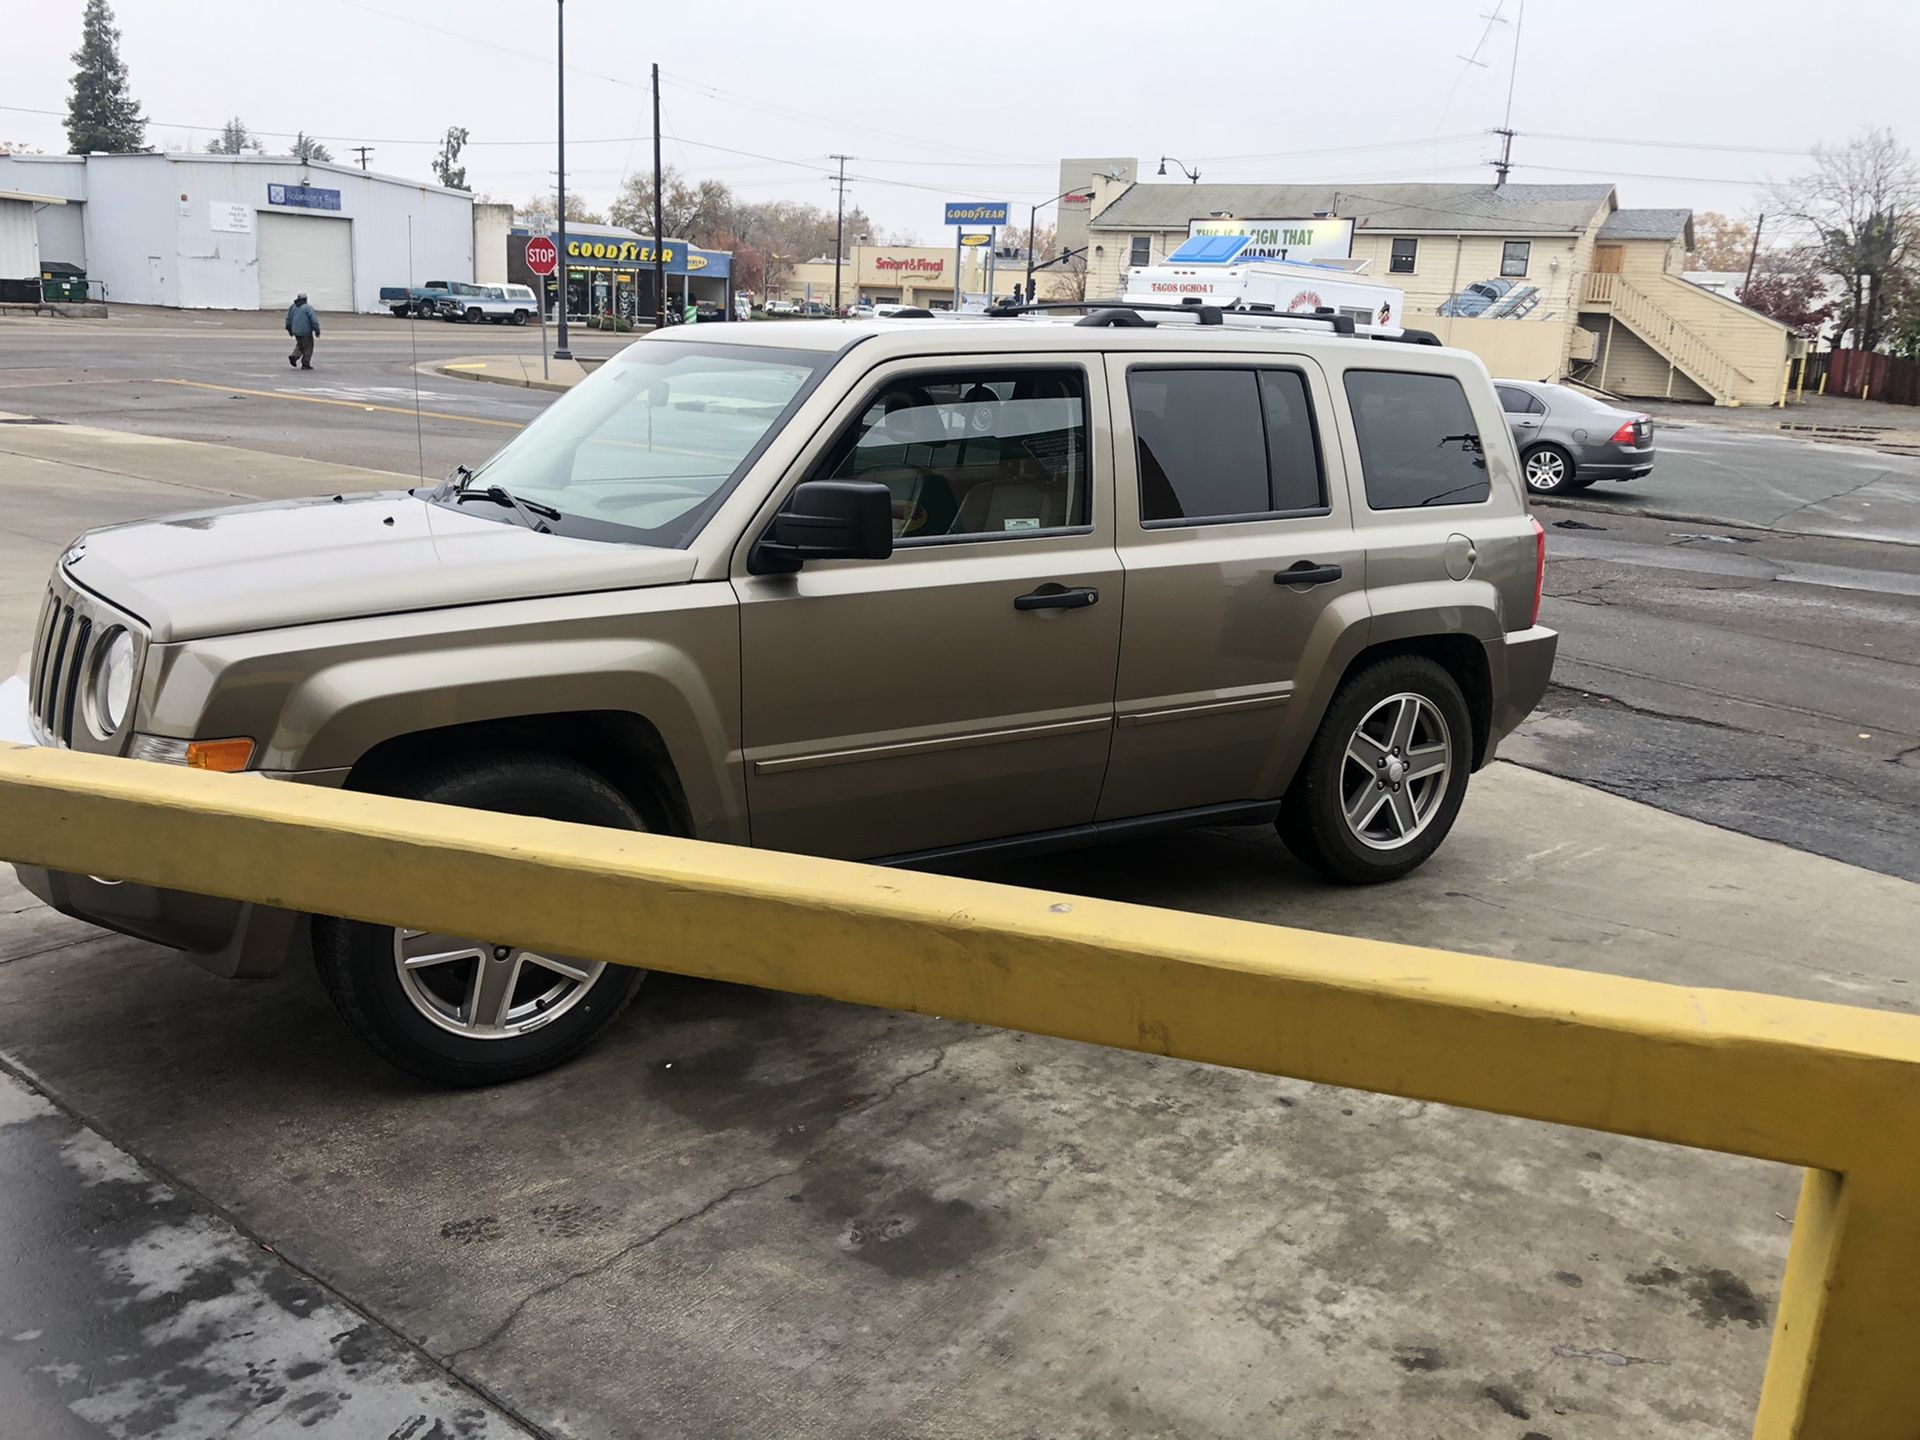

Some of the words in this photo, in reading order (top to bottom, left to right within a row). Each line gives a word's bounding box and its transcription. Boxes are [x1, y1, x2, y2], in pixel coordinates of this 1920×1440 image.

[947, 206, 1005, 221] GOODYEAR
[1250, 229, 1278, 245] SIGN
[1283, 229, 1314, 245] THAT
[528, 248, 555, 263] STOP
